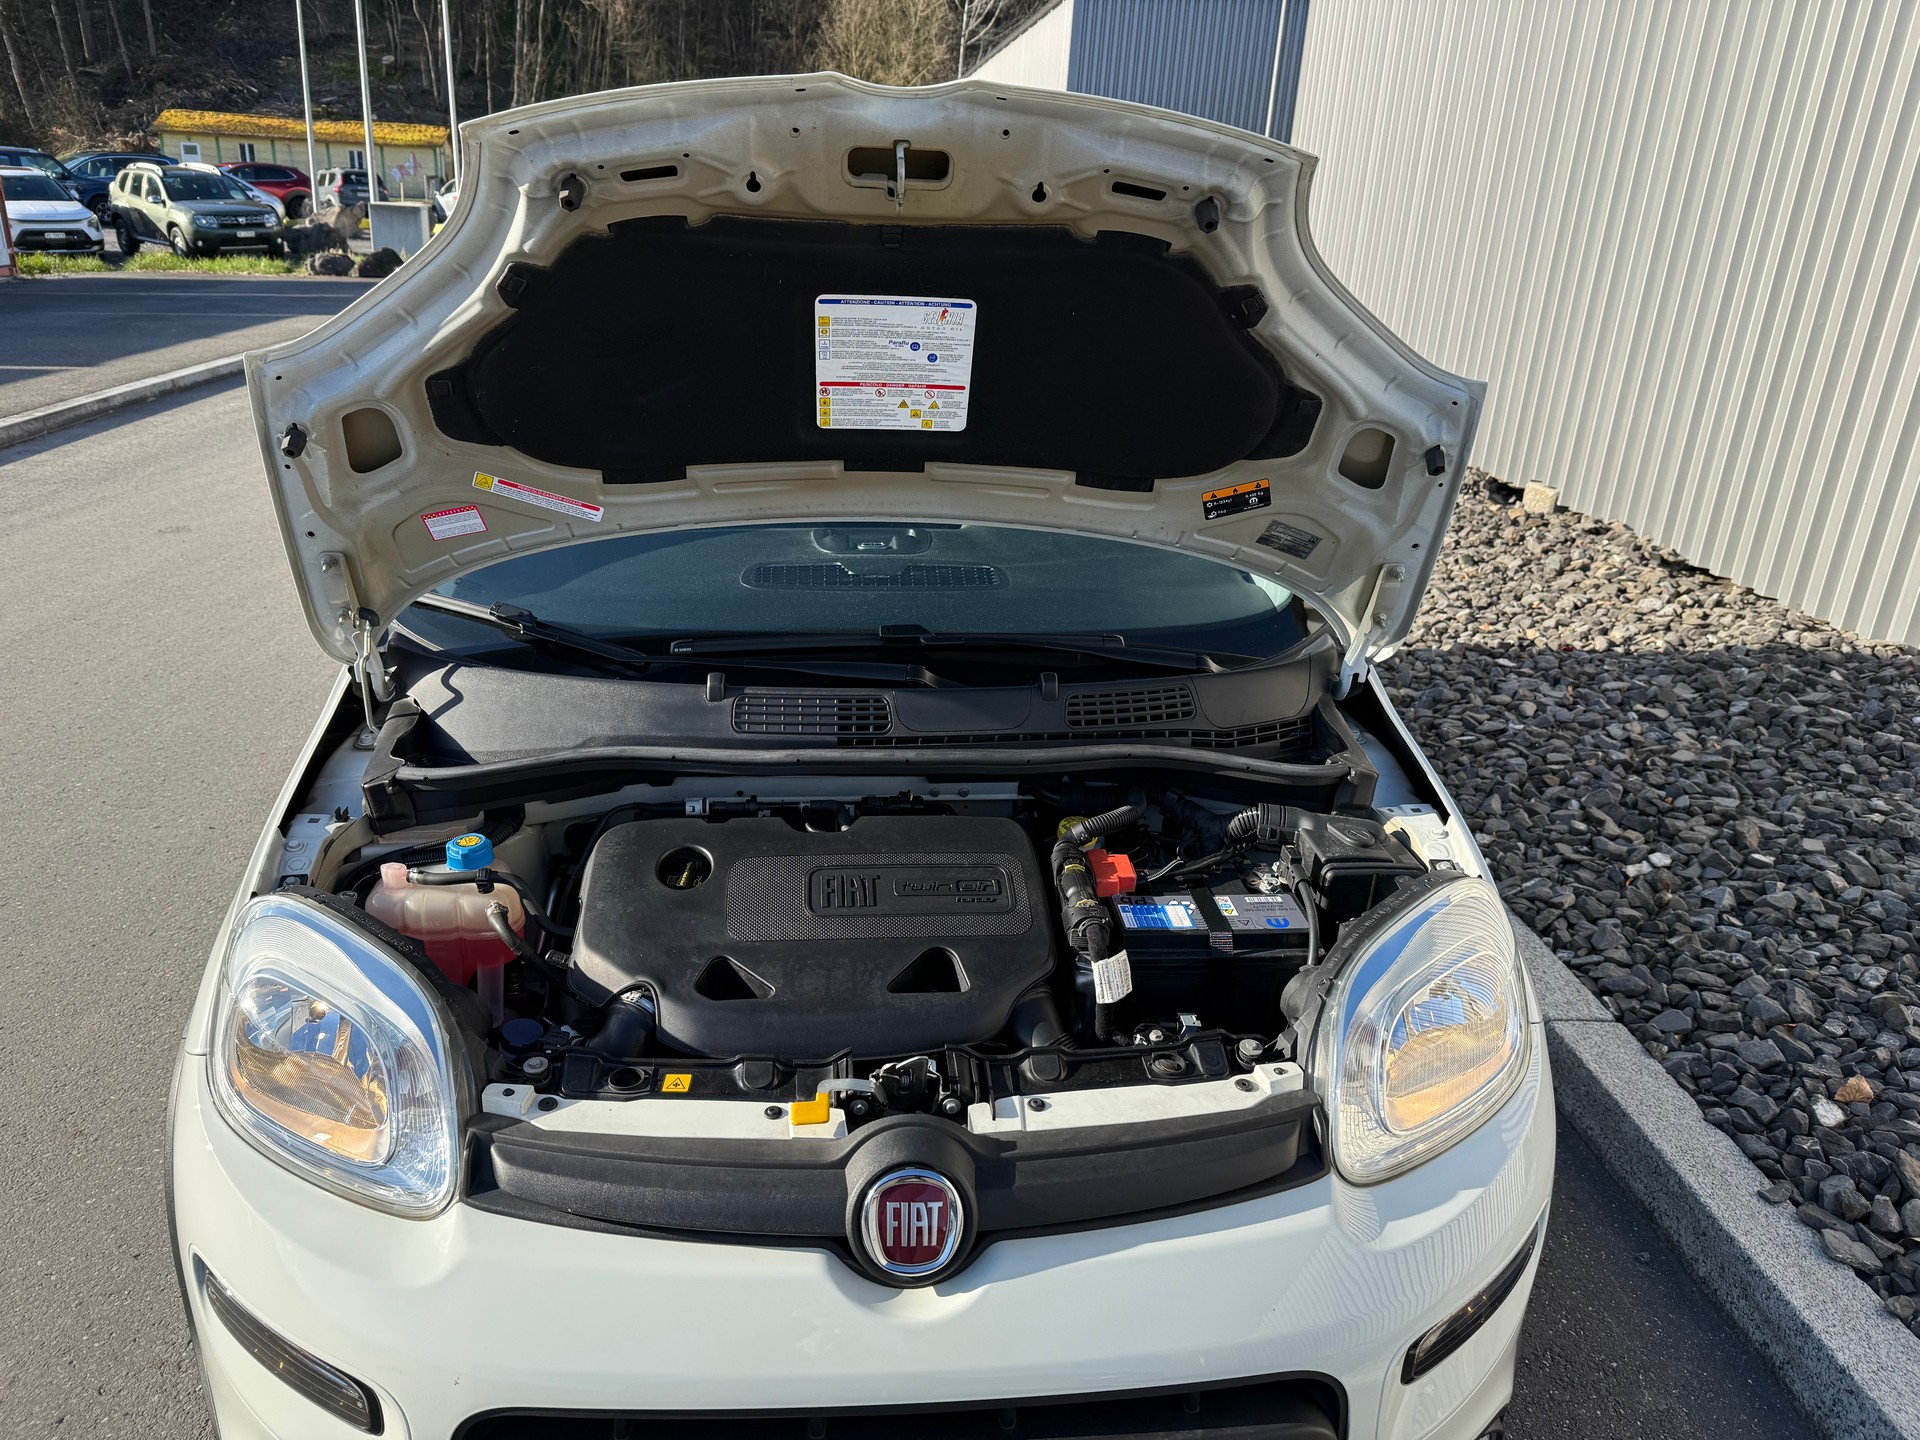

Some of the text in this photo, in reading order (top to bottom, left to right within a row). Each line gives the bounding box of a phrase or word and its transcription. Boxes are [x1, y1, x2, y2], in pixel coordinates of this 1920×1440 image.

[921, 309, 966, 327] SELENIA
[820, 874, 880, 908] FIAT
[886, 1201, 943, 1247] FIAT
